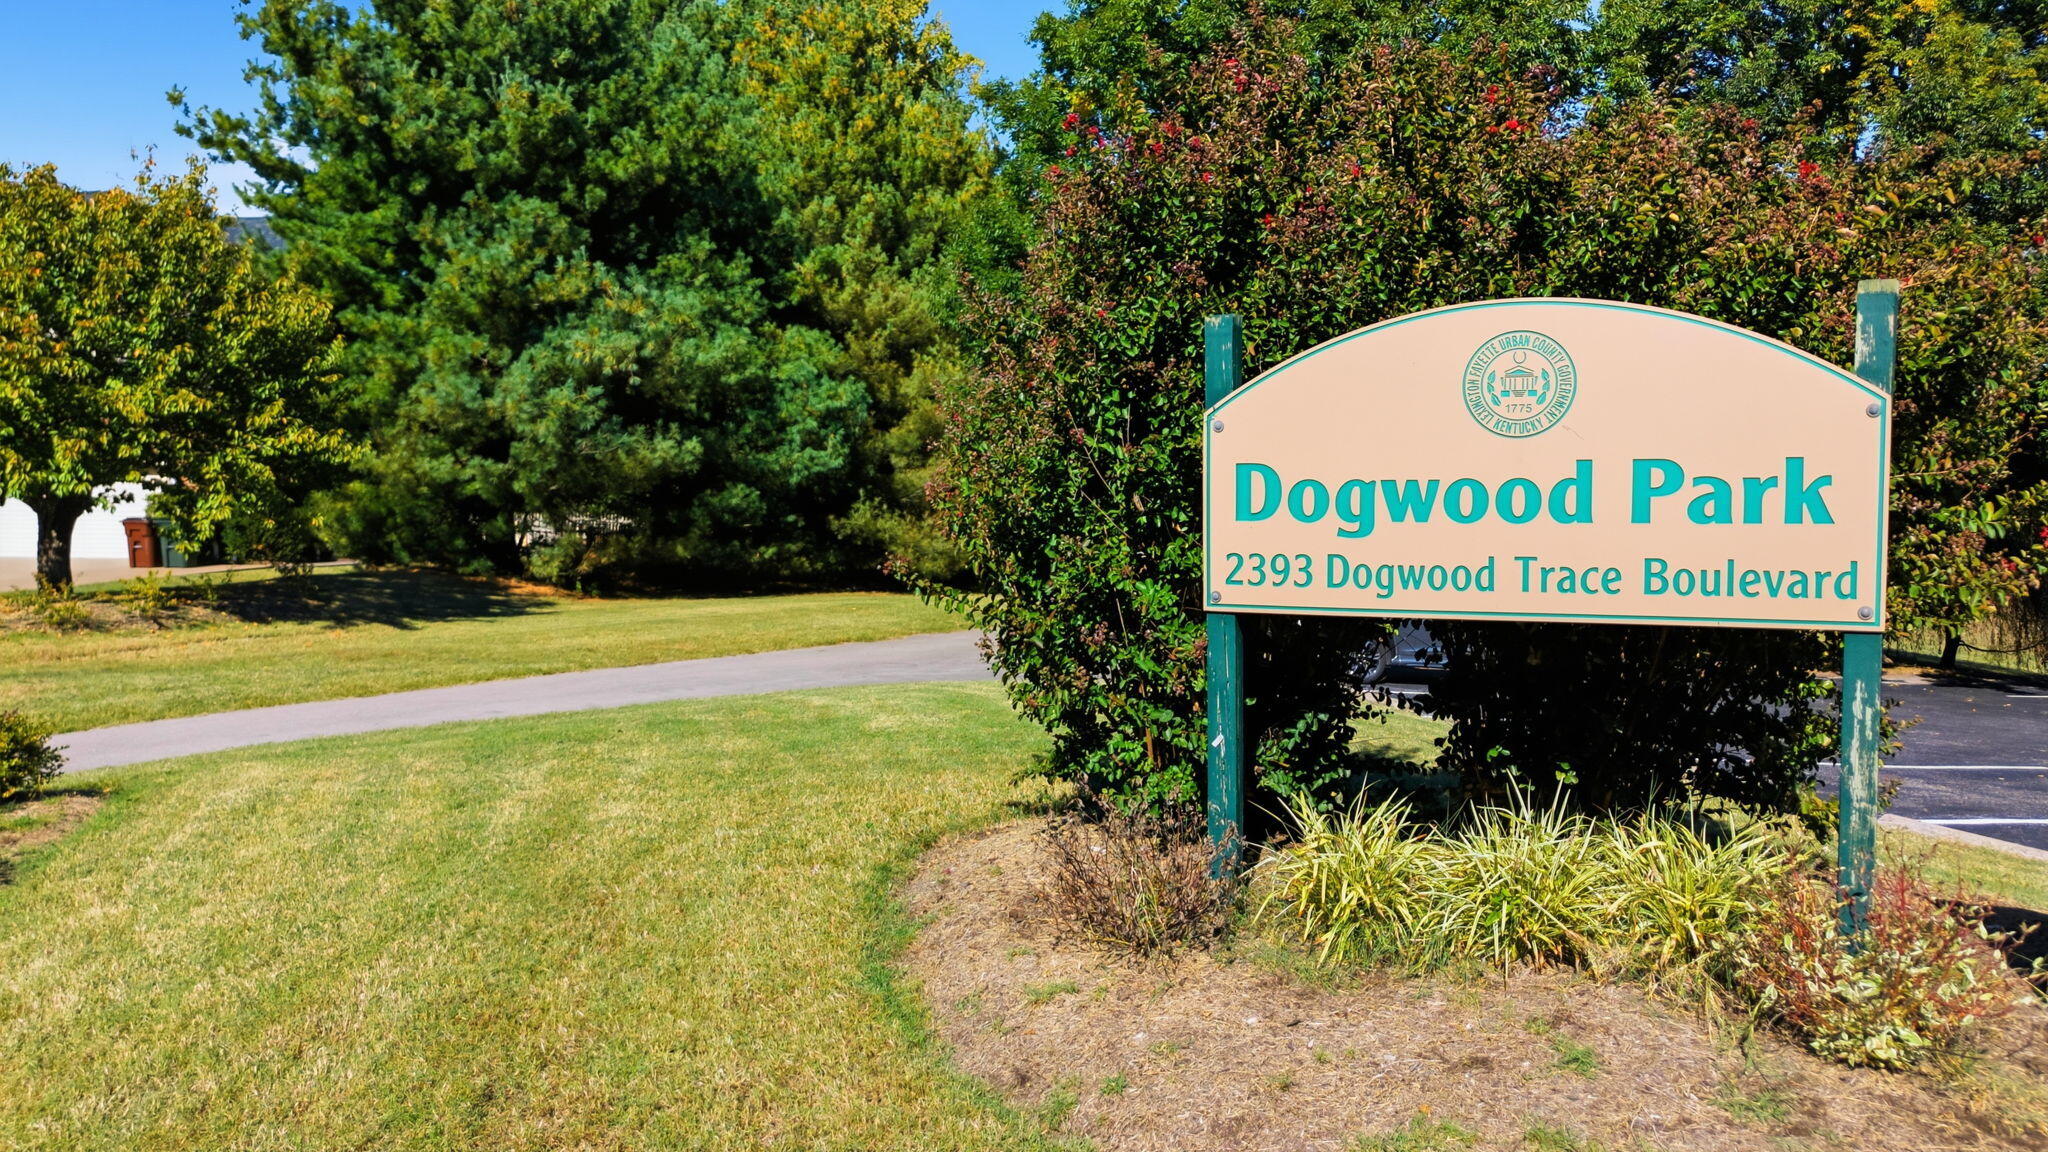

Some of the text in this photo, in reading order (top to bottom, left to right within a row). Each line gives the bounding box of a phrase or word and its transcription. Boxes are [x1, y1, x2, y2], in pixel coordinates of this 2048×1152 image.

[1467, 334, 1573, 425] LEXINGTON FAYETTE URBAN COUNTY GOVERNMENT
[1493, 416, 1544, 435] KENTUCKY
[1505, 403, 1533, 413] 1775
[1234, 456, 1836, 540] Dogwood Park
[1224, 552, 1859, 601] 2393 Dogwood Trace Boulevard
